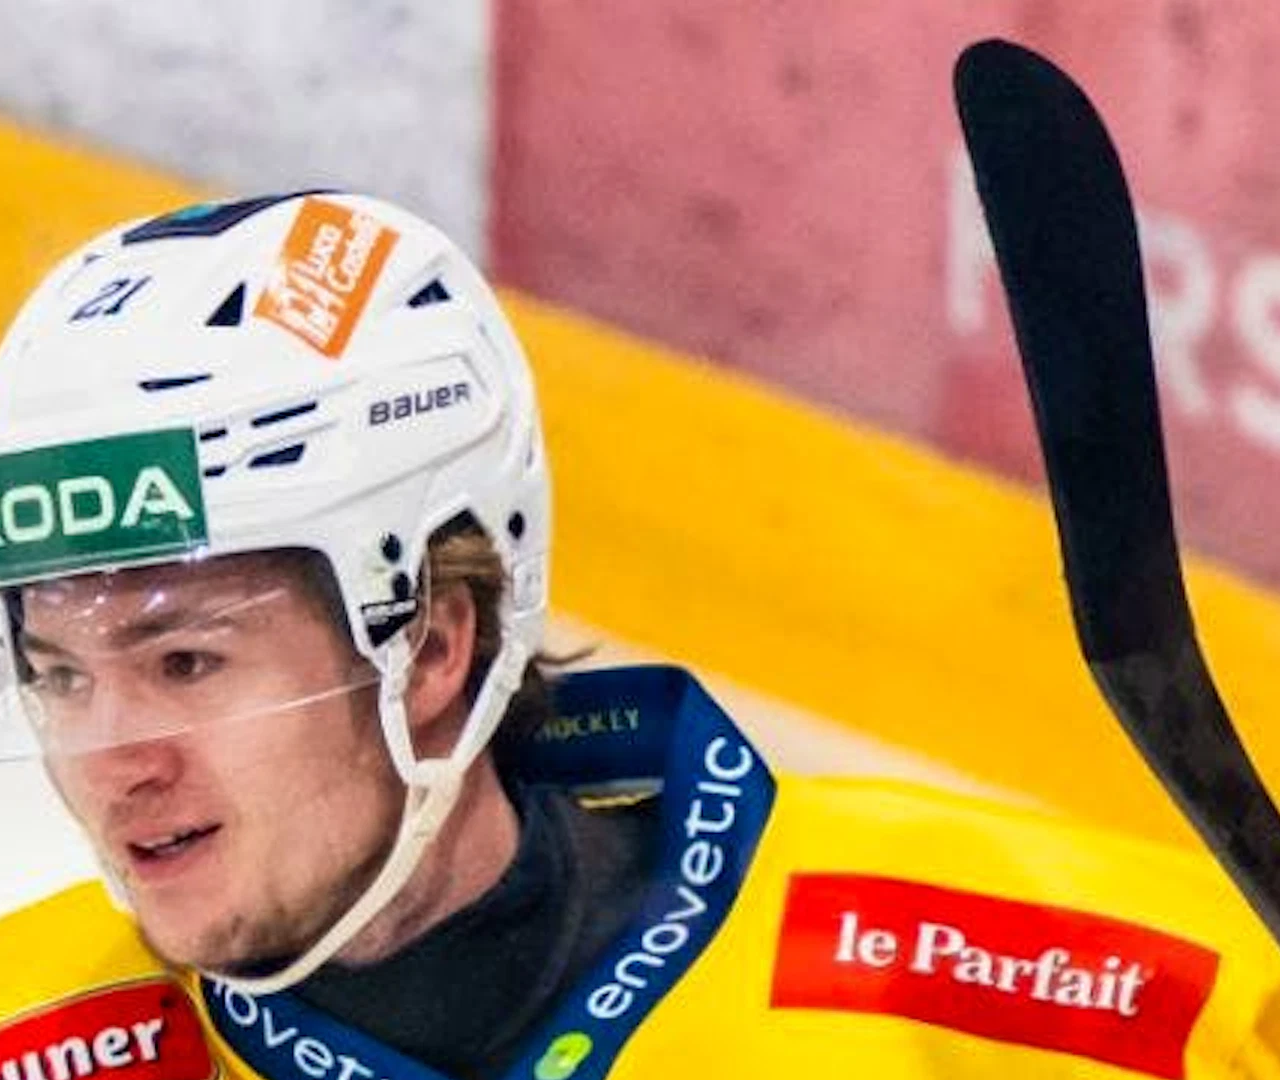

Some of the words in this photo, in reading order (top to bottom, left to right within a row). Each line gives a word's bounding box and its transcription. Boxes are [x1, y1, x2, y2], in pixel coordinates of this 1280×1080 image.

[69, 275, 152, 323] 21
[586, 736, 754, 1019] enovetic
[833, 910, 897, 968] le
[909, 921, 1145, 1017] Parfait
